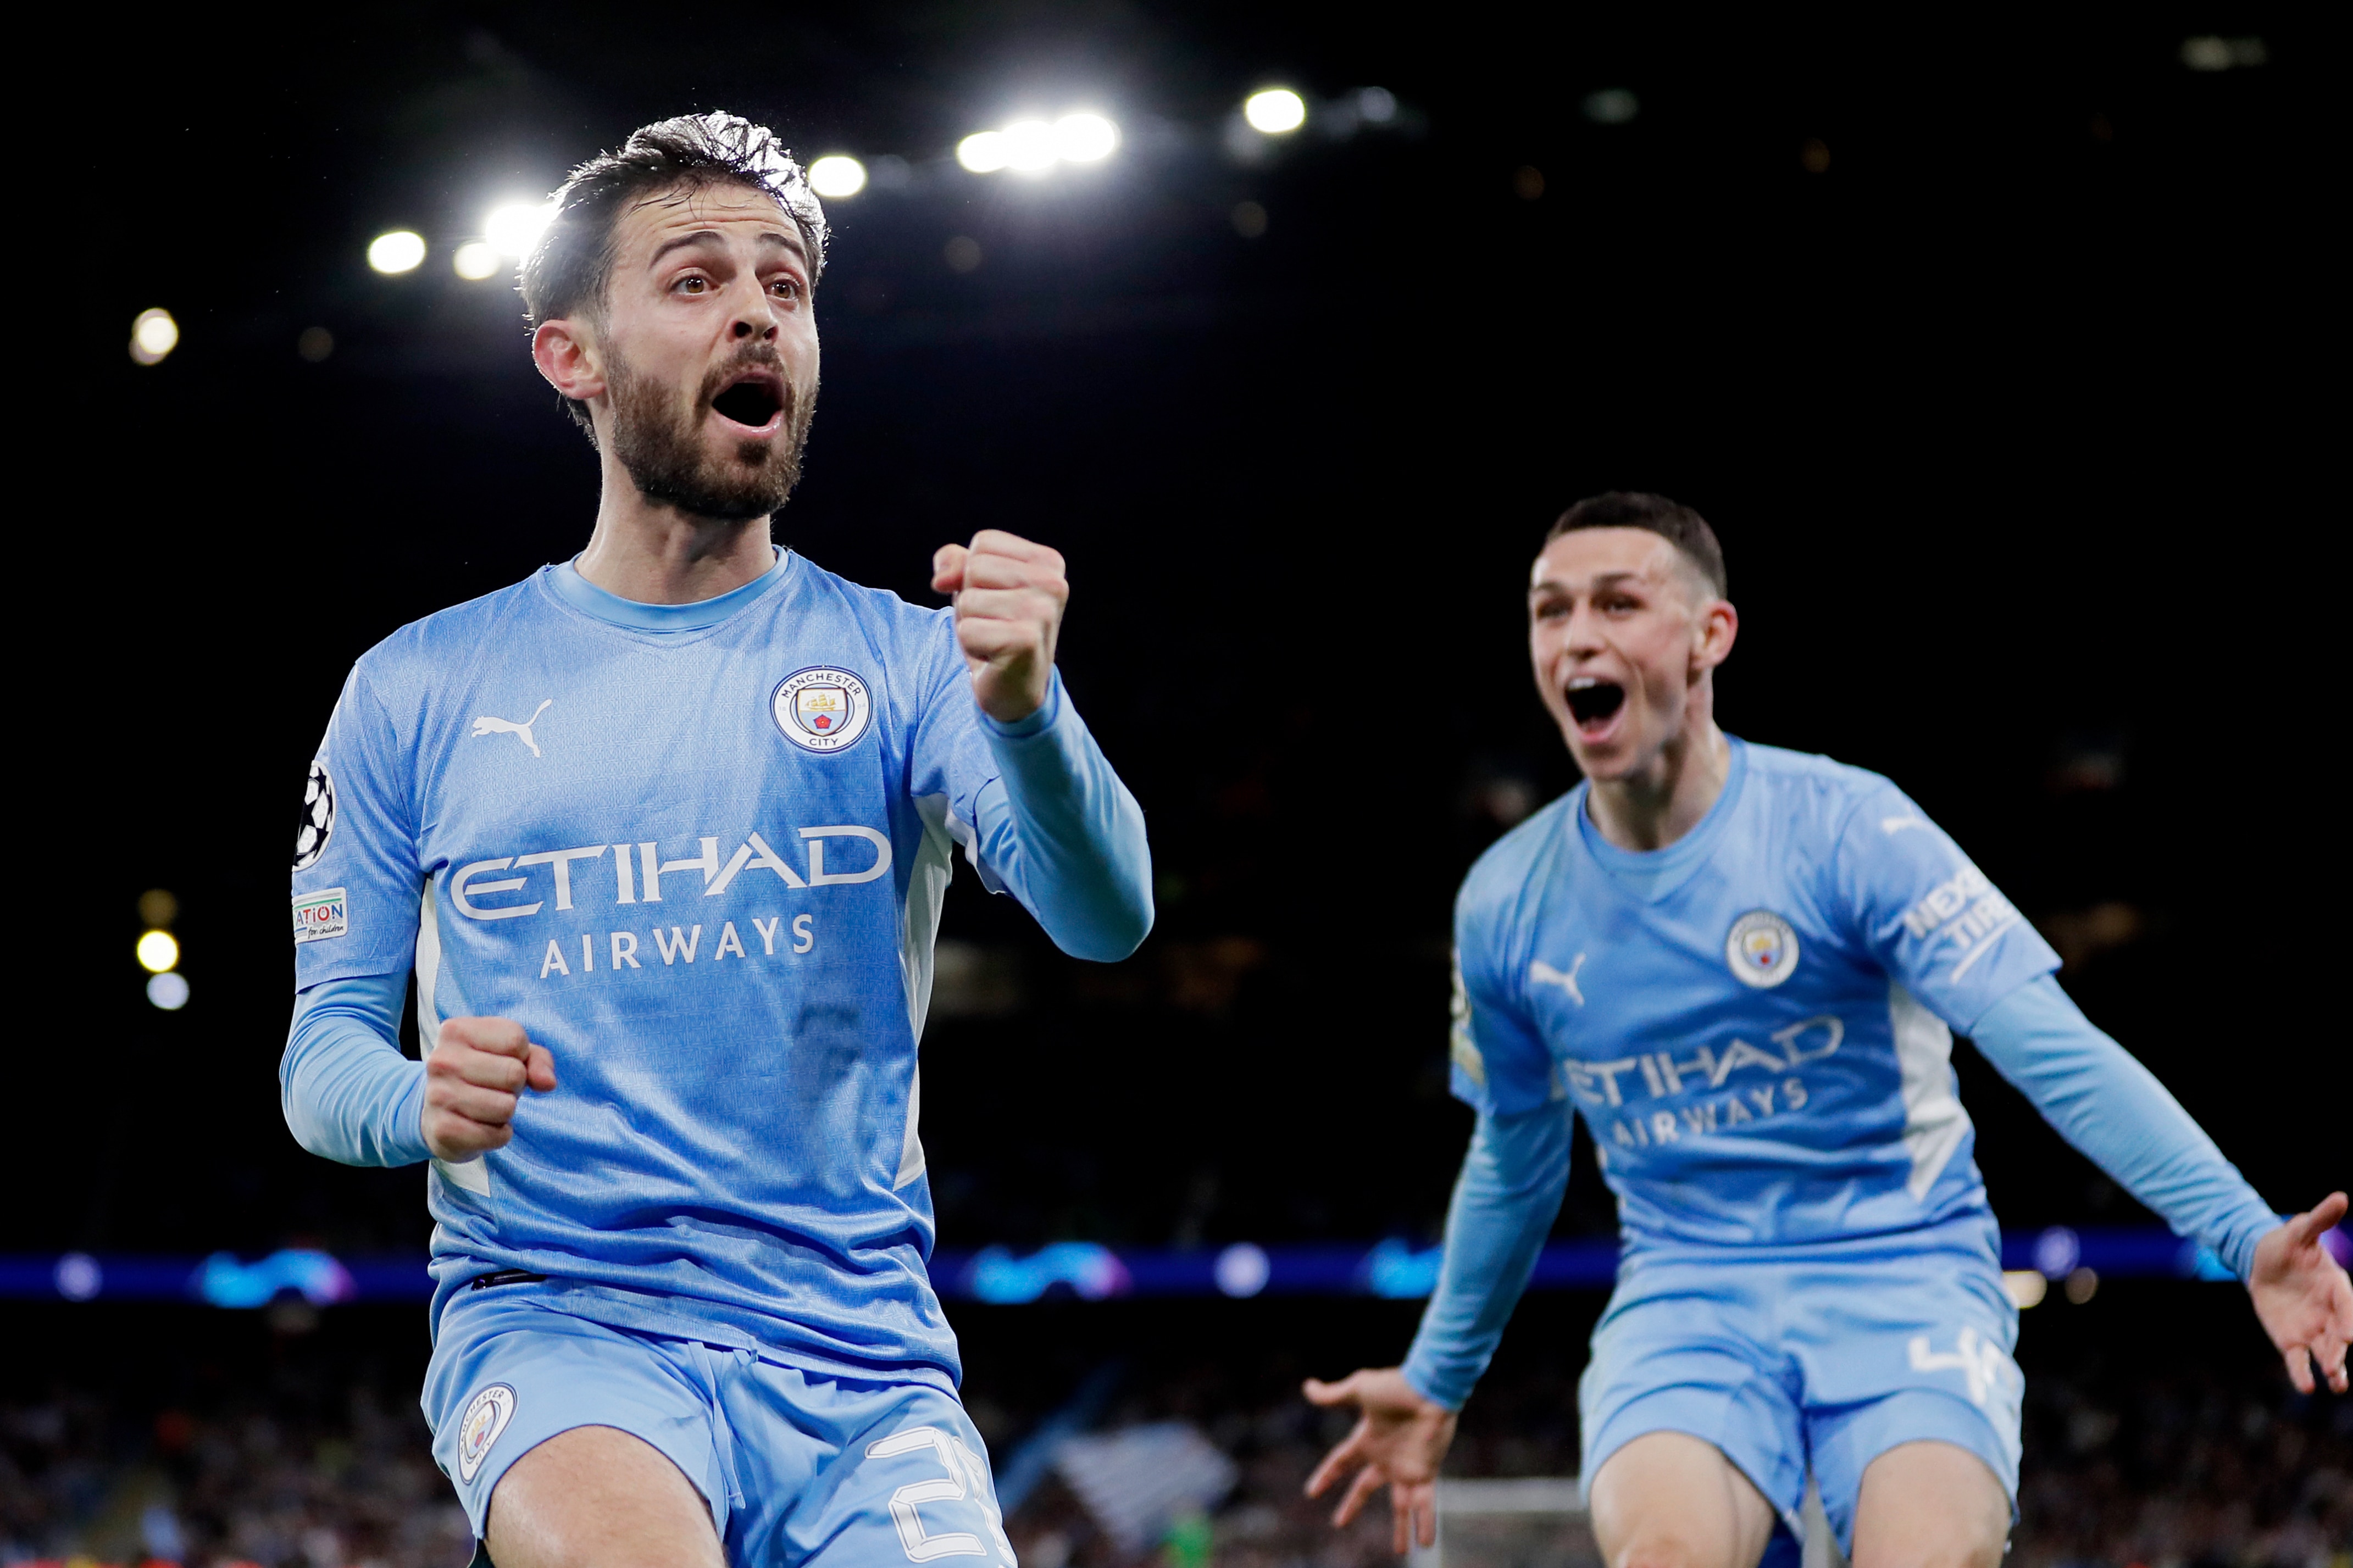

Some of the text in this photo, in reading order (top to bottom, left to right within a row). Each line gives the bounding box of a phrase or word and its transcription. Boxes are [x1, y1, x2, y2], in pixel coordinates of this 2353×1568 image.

[781, 673, 861, 698] MANCHESTER
[809, 738, 839, 746] CITY
[450, 825, 893, 920] ETIHAD
[308, 924, 344, 939] for children
[540, 914, 815, 979] AIRWAYS
[1563, 1014, 1845, 1107] ETIHAD
[1612, 1077, 1808, 1148] AIRWAYS
[460, 1389, 504, 1455] MANCHESTER
[475, 1439, 491, 1466] CITY
